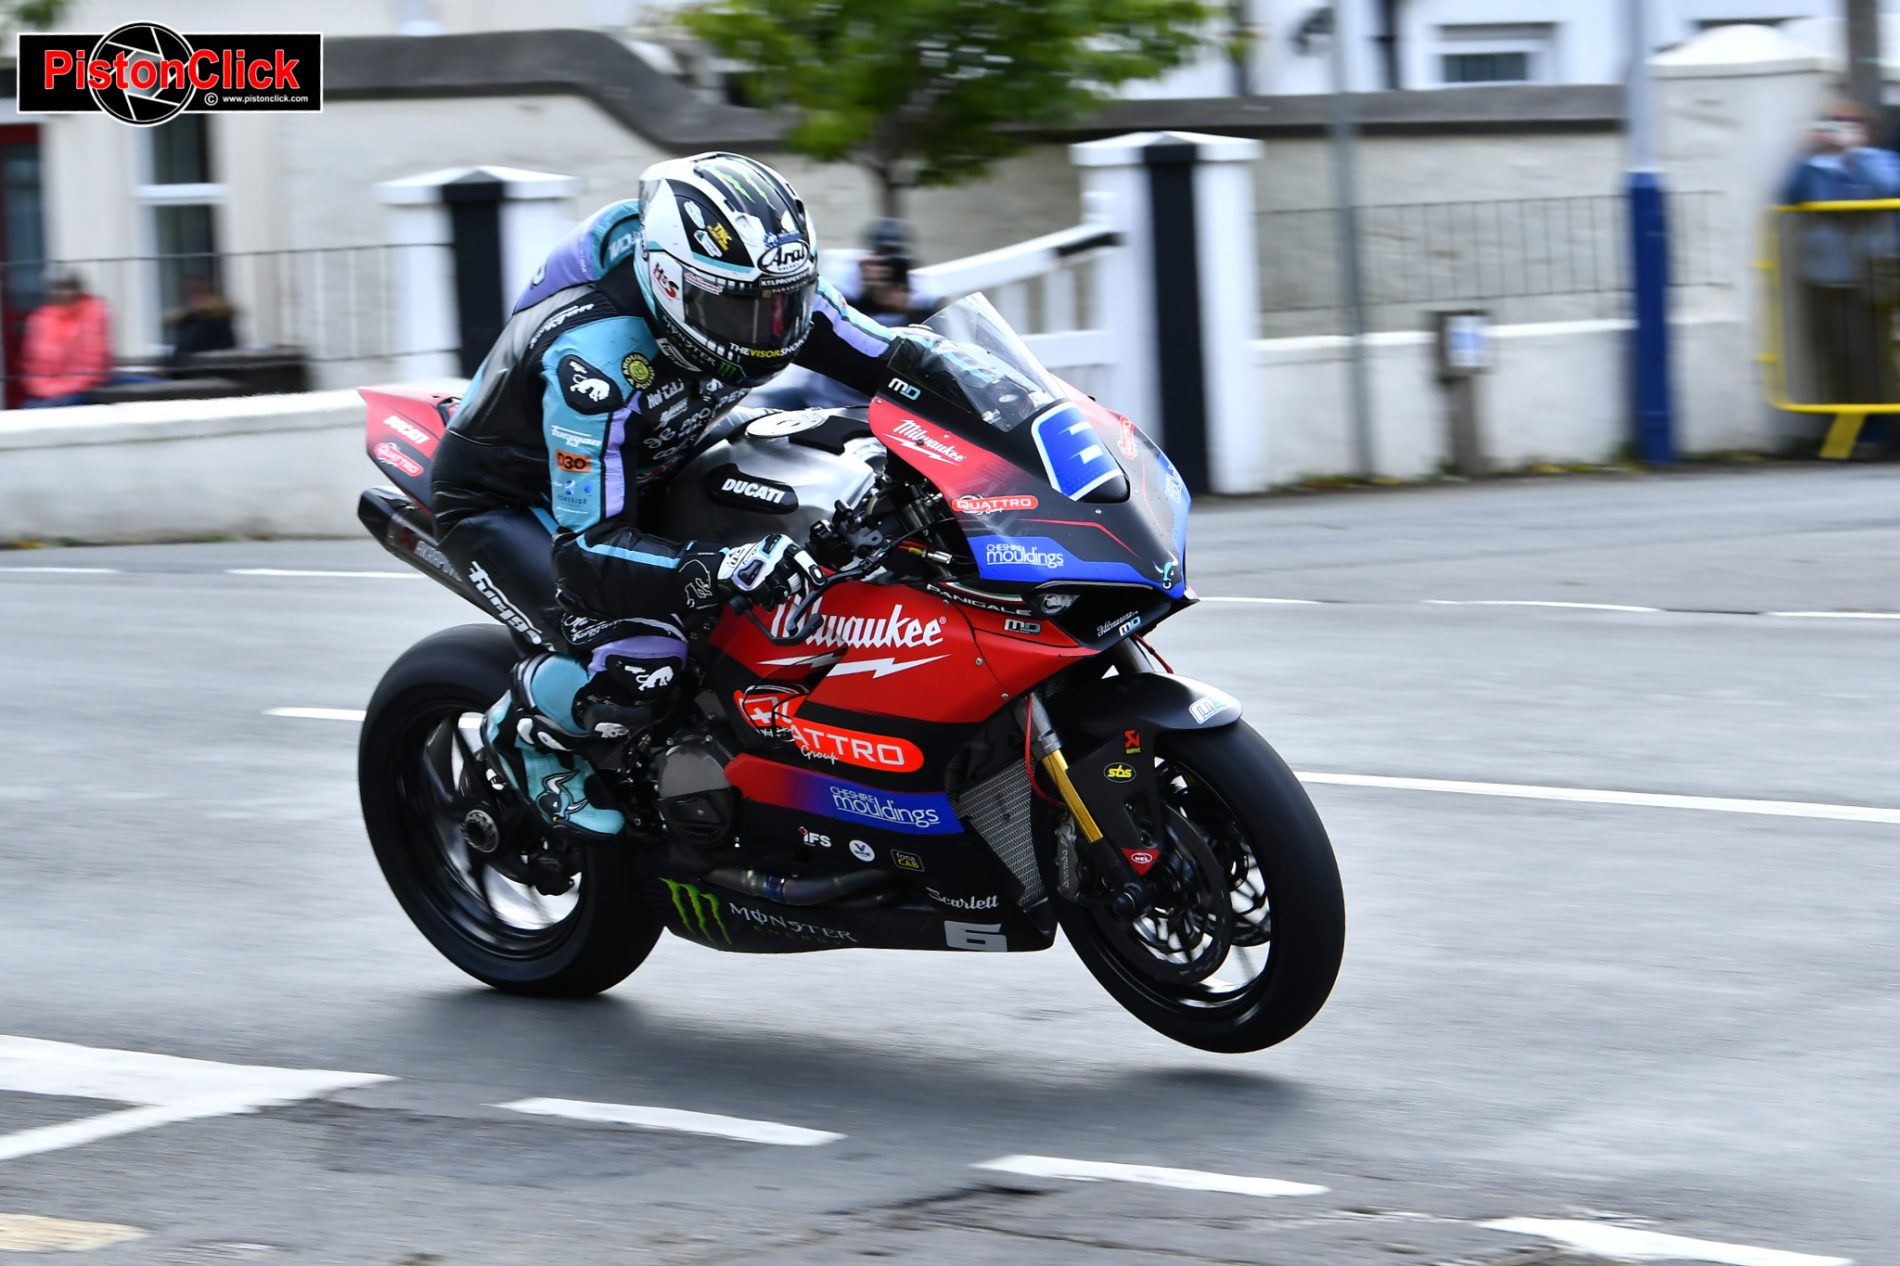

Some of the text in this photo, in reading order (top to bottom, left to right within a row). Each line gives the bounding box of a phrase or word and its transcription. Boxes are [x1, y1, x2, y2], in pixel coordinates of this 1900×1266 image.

[762, 241, 805, 267] Arai
[383, 415, 430, 444] DUCATI
[893, 419, 965, 462] Milwaukee
[722, 478, 785, 503] DUCATI
[956, 498, 1033, 512] QUATTRO
[986, 543, 1025, 553] CHESHIRE
[986, 547, 1065, 569] mouldings
[926, 583, 1032, 617] PANIGALE
[800, 744, 839, 766] Group
[1107, 764, 1132, 778] sbs
[830, 786, 876, 804] CHESHIRE
[832, 796, 940, 828] mouldings
[925, 886, 1000, 910] Scarlett
[943, 920, 1008, 953] 6
